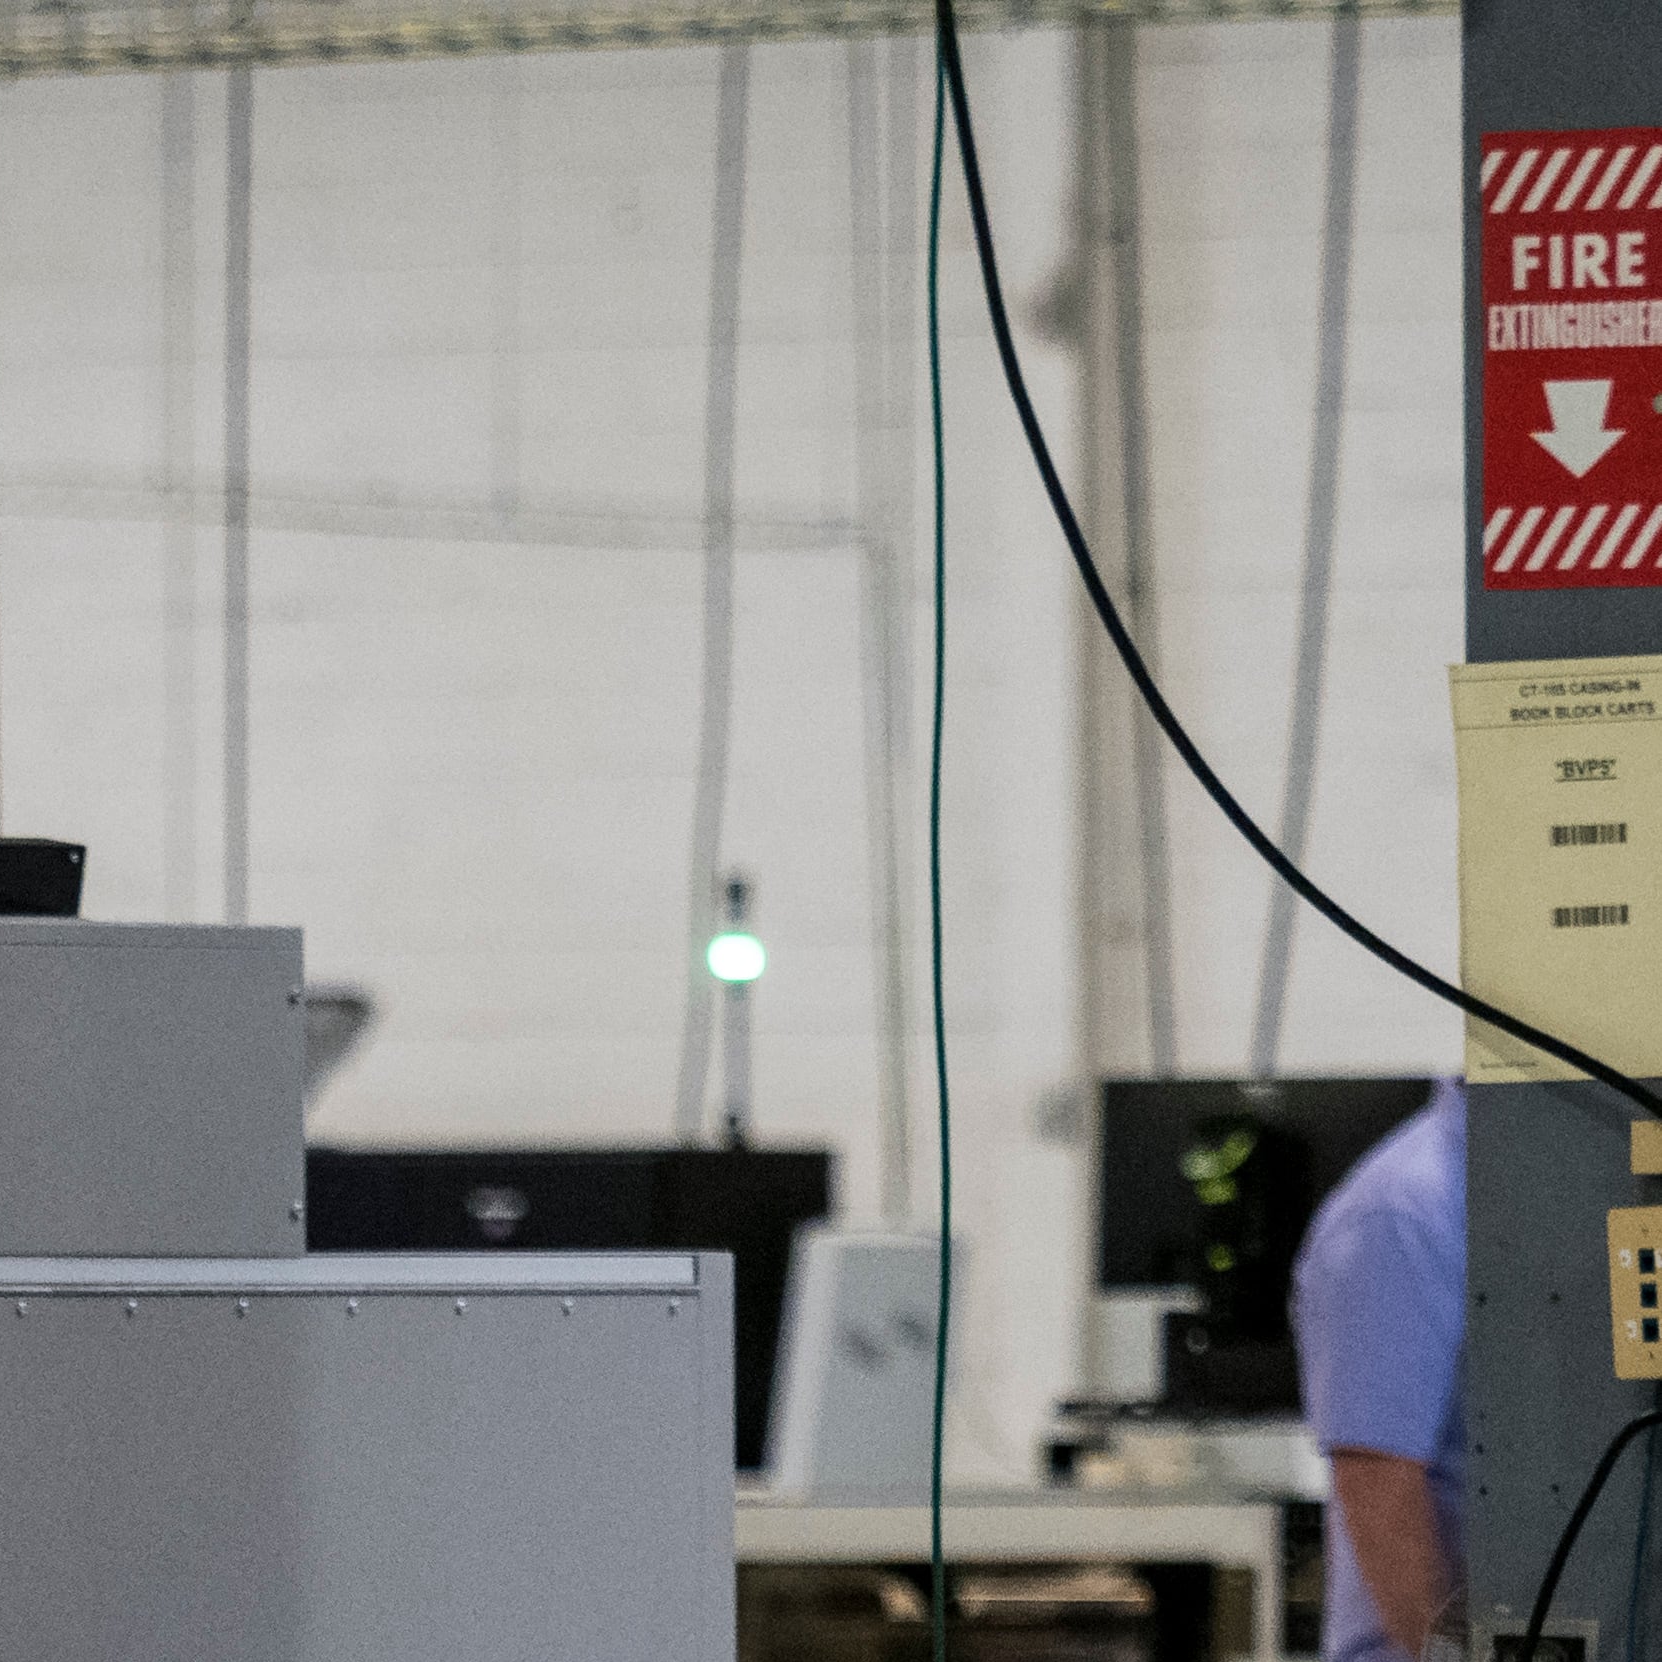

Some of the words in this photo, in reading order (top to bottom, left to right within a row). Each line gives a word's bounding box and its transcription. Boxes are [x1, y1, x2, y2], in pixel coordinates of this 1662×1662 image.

[1512, 231, 1646, 291] FIRE
[1554, 704, 1602, 719] BLOCK
[1606, 701, 1655, 716] CARTS
